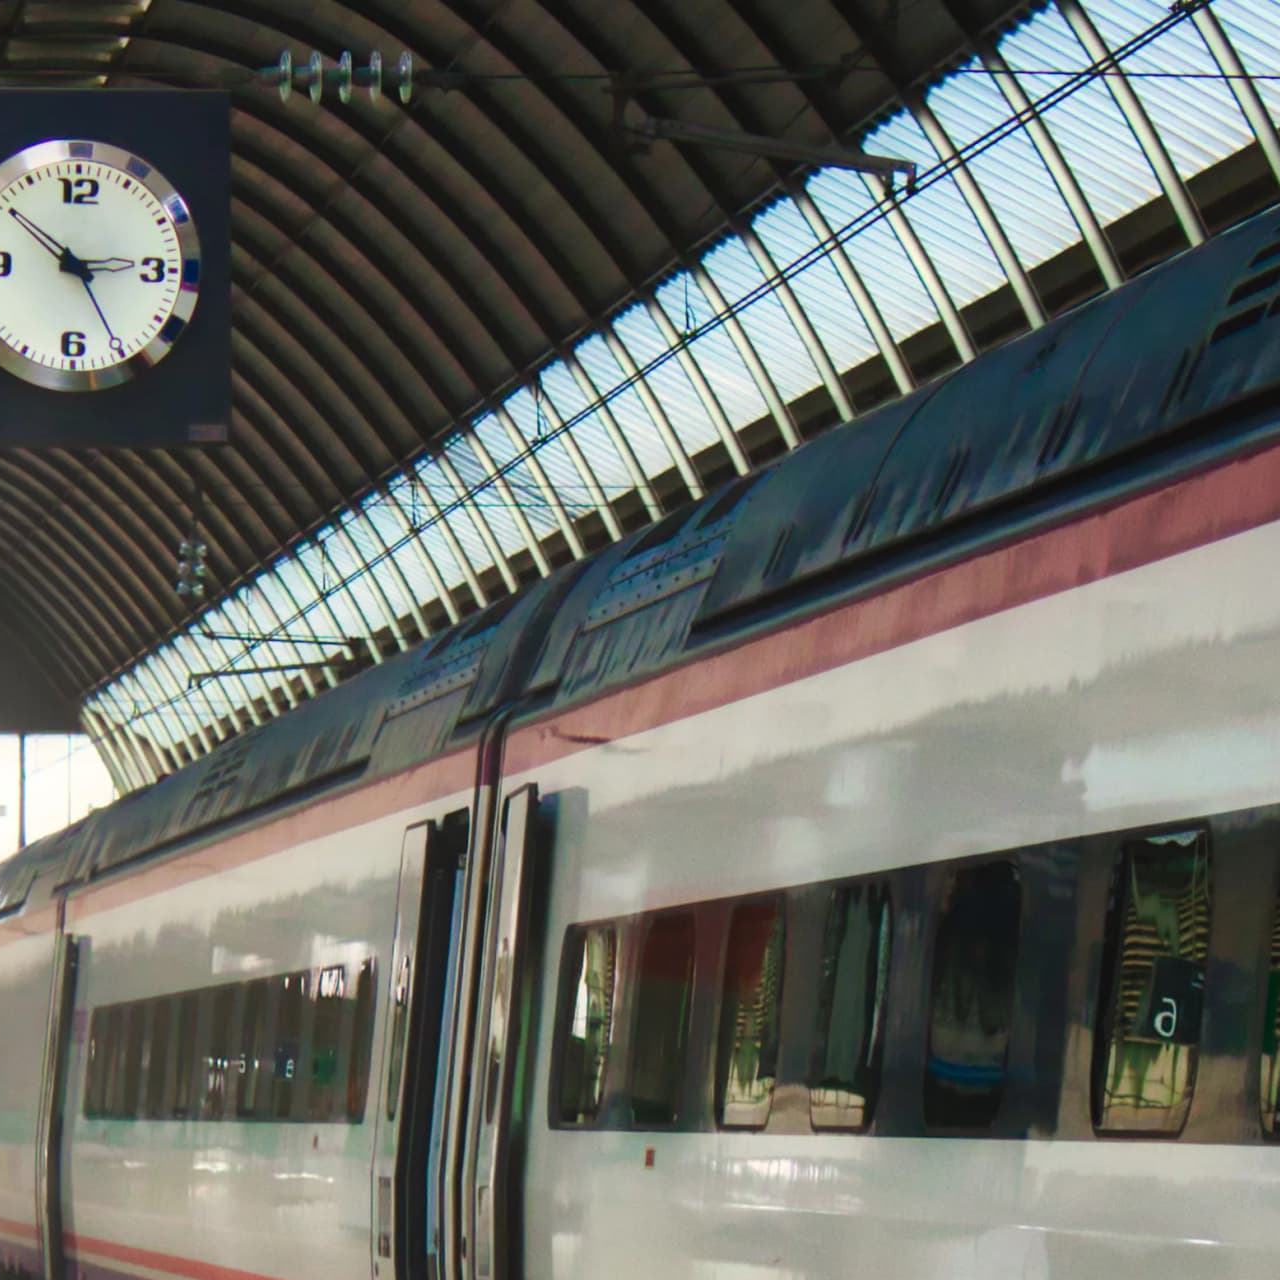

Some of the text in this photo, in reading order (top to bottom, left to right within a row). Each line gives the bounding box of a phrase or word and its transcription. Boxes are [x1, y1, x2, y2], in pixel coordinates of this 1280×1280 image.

[58, 178, 100, 205] 12
[139, 257, 165, 283] 3
[60, 331, 86, 357] 6
